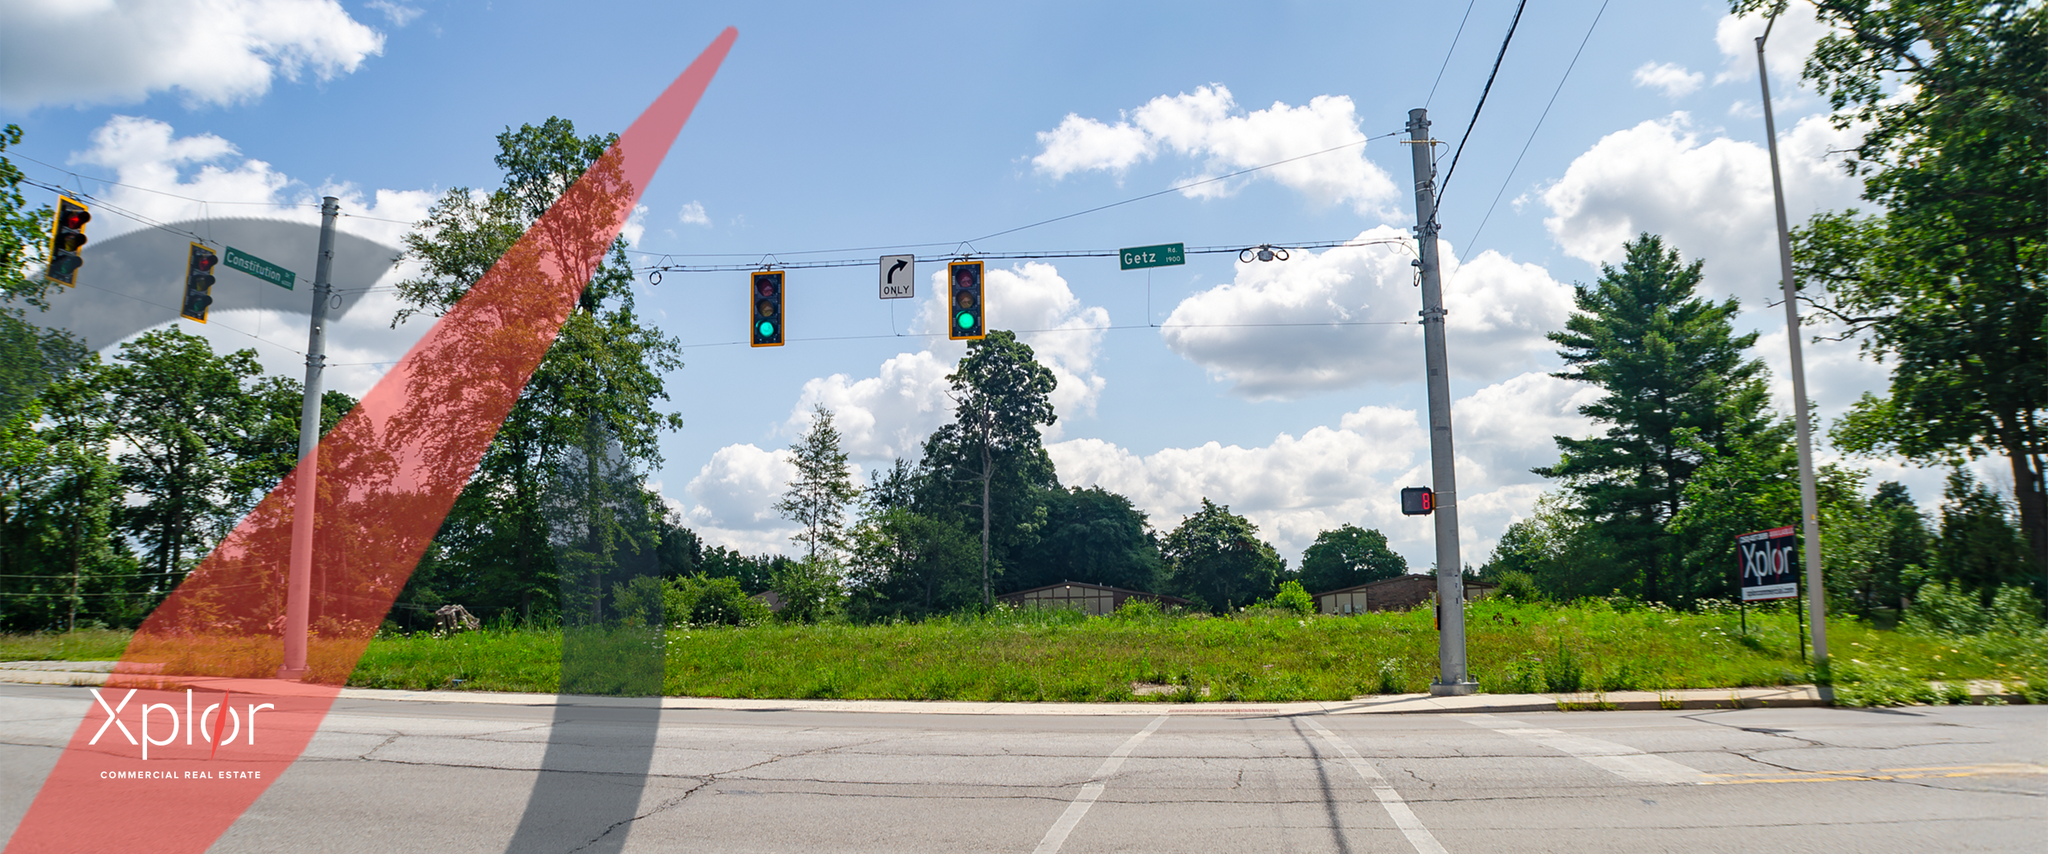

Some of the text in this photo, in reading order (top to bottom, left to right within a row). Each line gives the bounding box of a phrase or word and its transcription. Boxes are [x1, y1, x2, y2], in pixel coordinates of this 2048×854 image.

[226, 251, 281, 281] Constitution
[1124, 251, 1156, 265] Getz
[883, 285, 910, 295] ONLY
[1422, 492, 1430, 510] 8
[1741, 541, 1793, 586] Xplor
